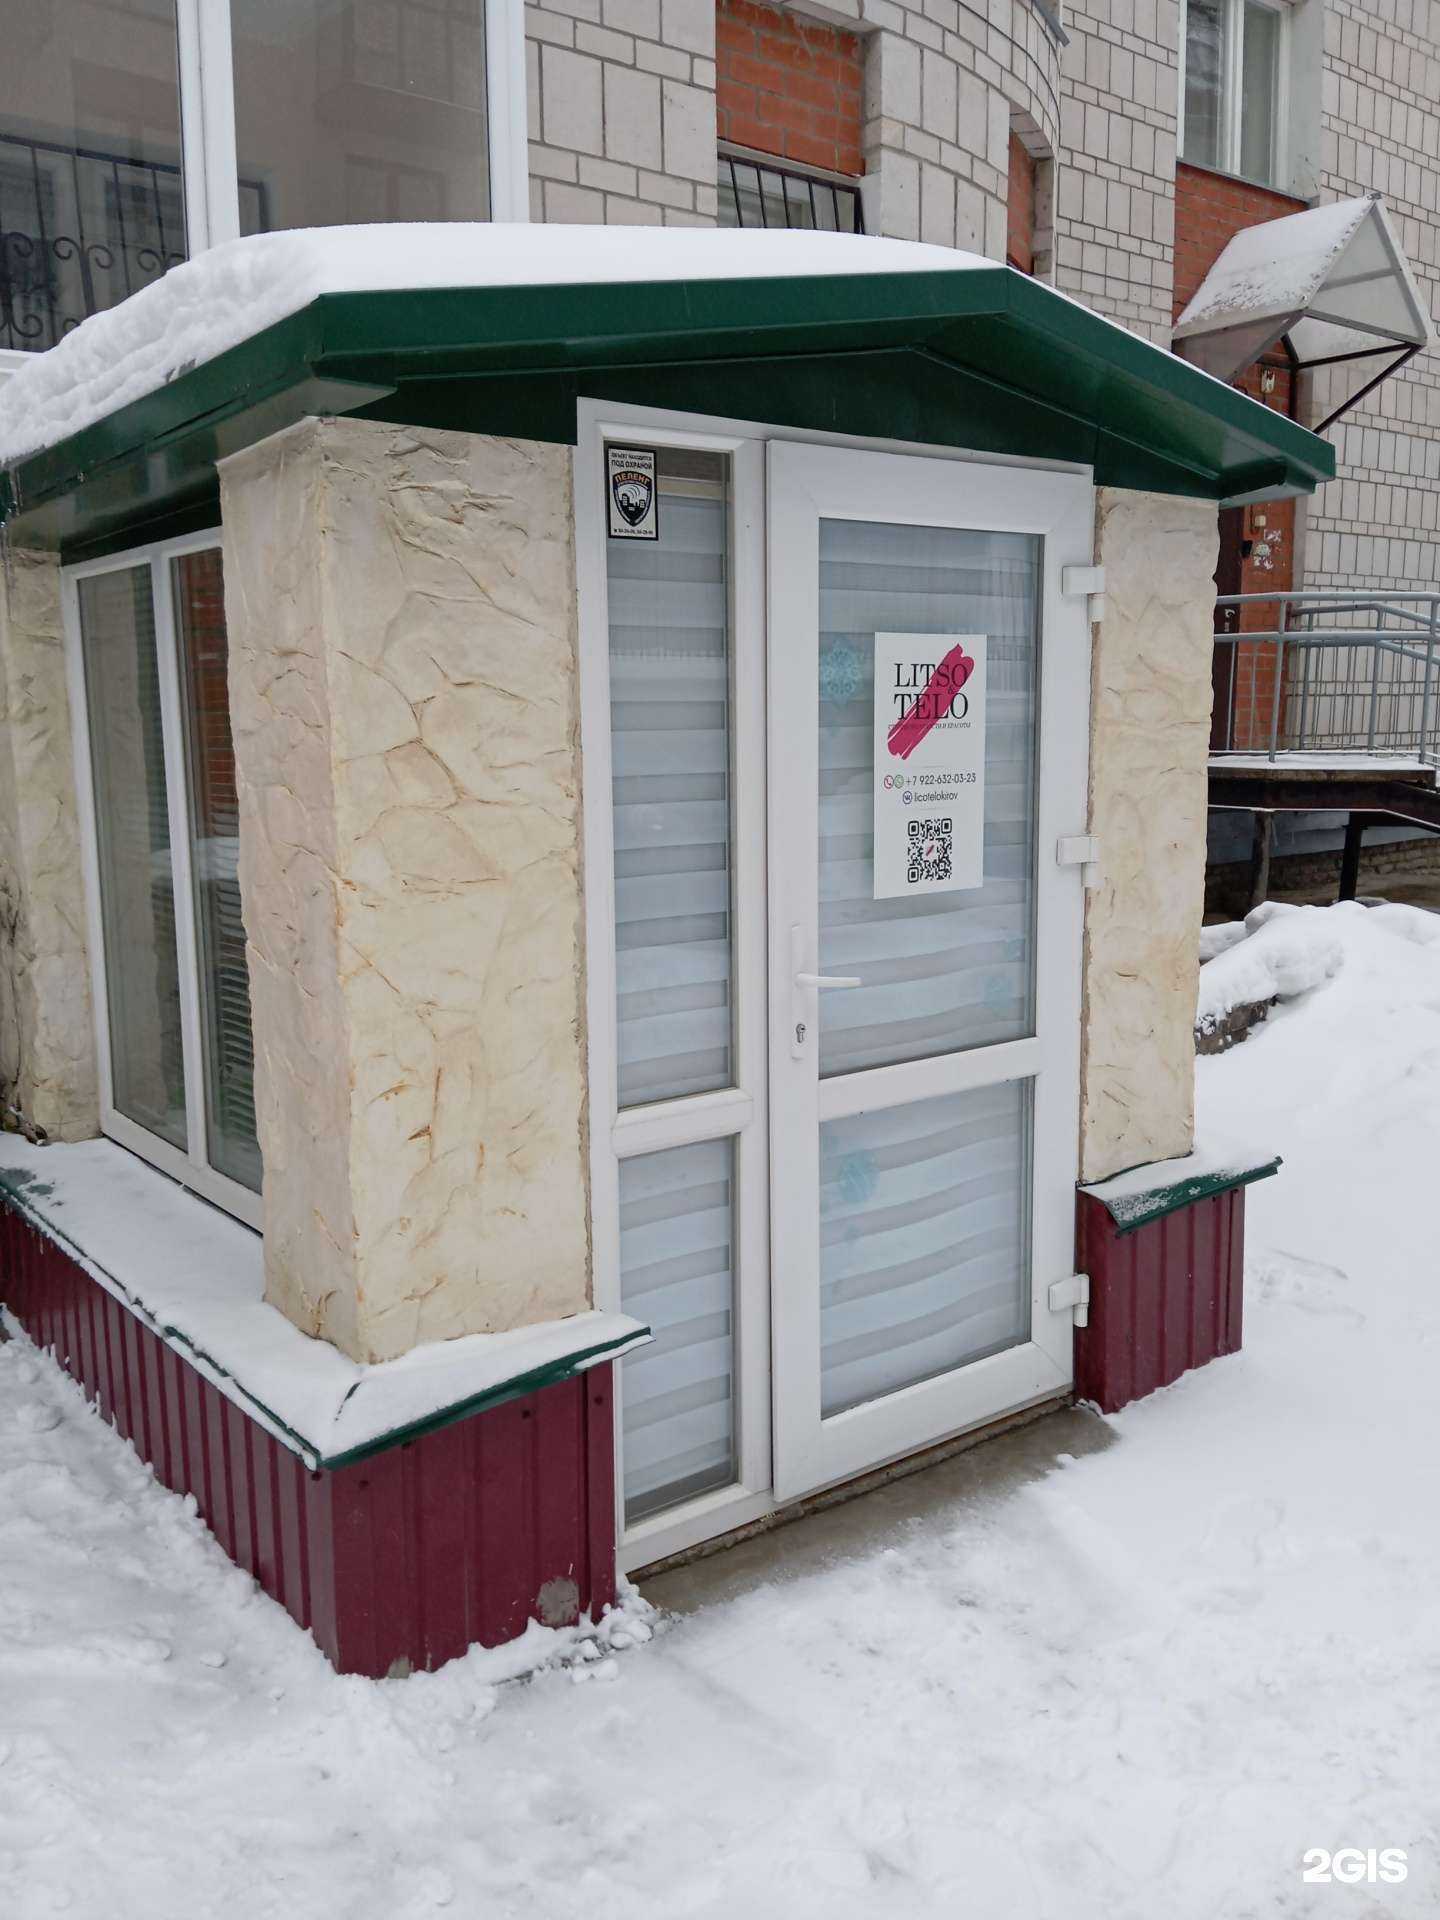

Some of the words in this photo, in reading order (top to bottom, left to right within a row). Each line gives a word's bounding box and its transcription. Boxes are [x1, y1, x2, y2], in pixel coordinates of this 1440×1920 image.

[612, 460, 624, 468] ПОД
[625, 461, 652, 470] ОХРАНОЙ
[616, 473, 650, 484] ПЕЛЕНГ
[894, 663, 968, 688] LITSO
[893, 693, 969, 720] TELO
[905, 776, 917, 786] +7
[919, 773, 976, 785] 922-632-03-23
